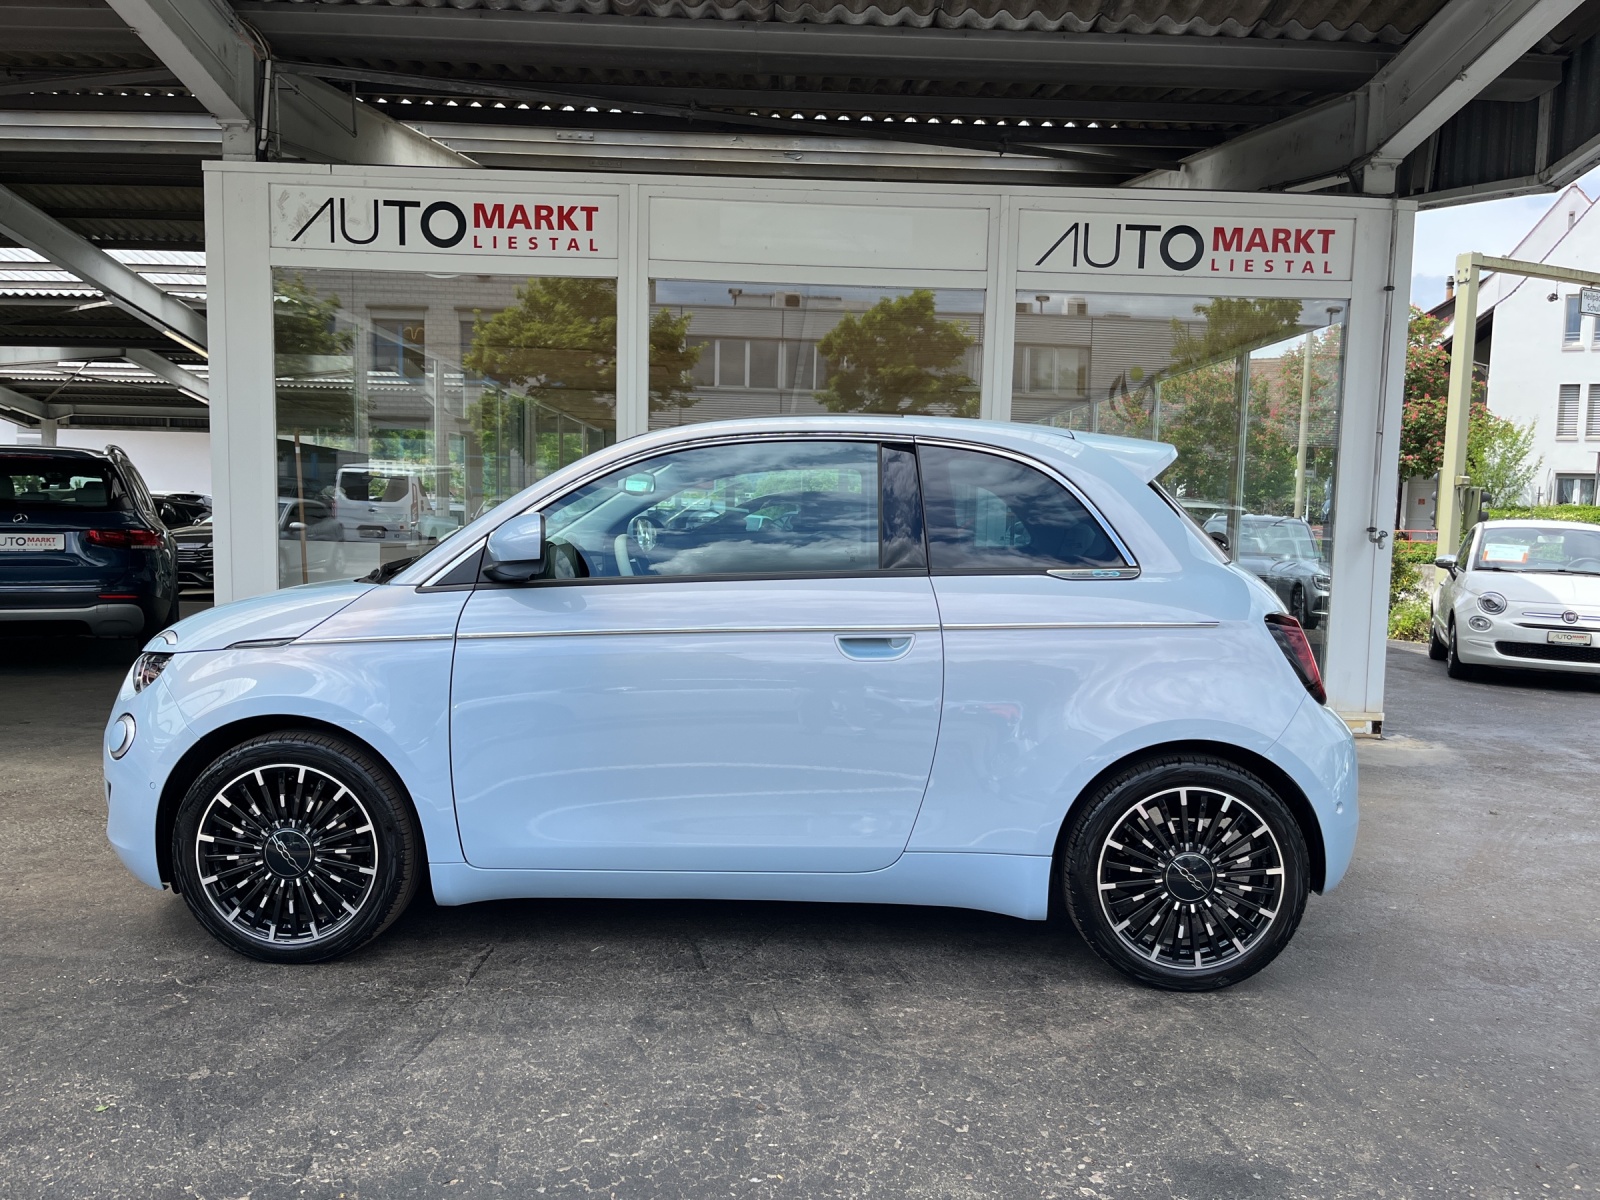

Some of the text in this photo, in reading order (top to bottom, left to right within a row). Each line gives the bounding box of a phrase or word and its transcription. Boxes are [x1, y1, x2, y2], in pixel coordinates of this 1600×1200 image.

[290, 197, 599, 249] AUTO MARKT
[473, 235, 599, 252] LIESTAL
[1035, 222, 1336, 272] AUTO MARKT
[1210, 258, 1333, 274] LIESTAL
[0, 537, 27, 546] UTO
